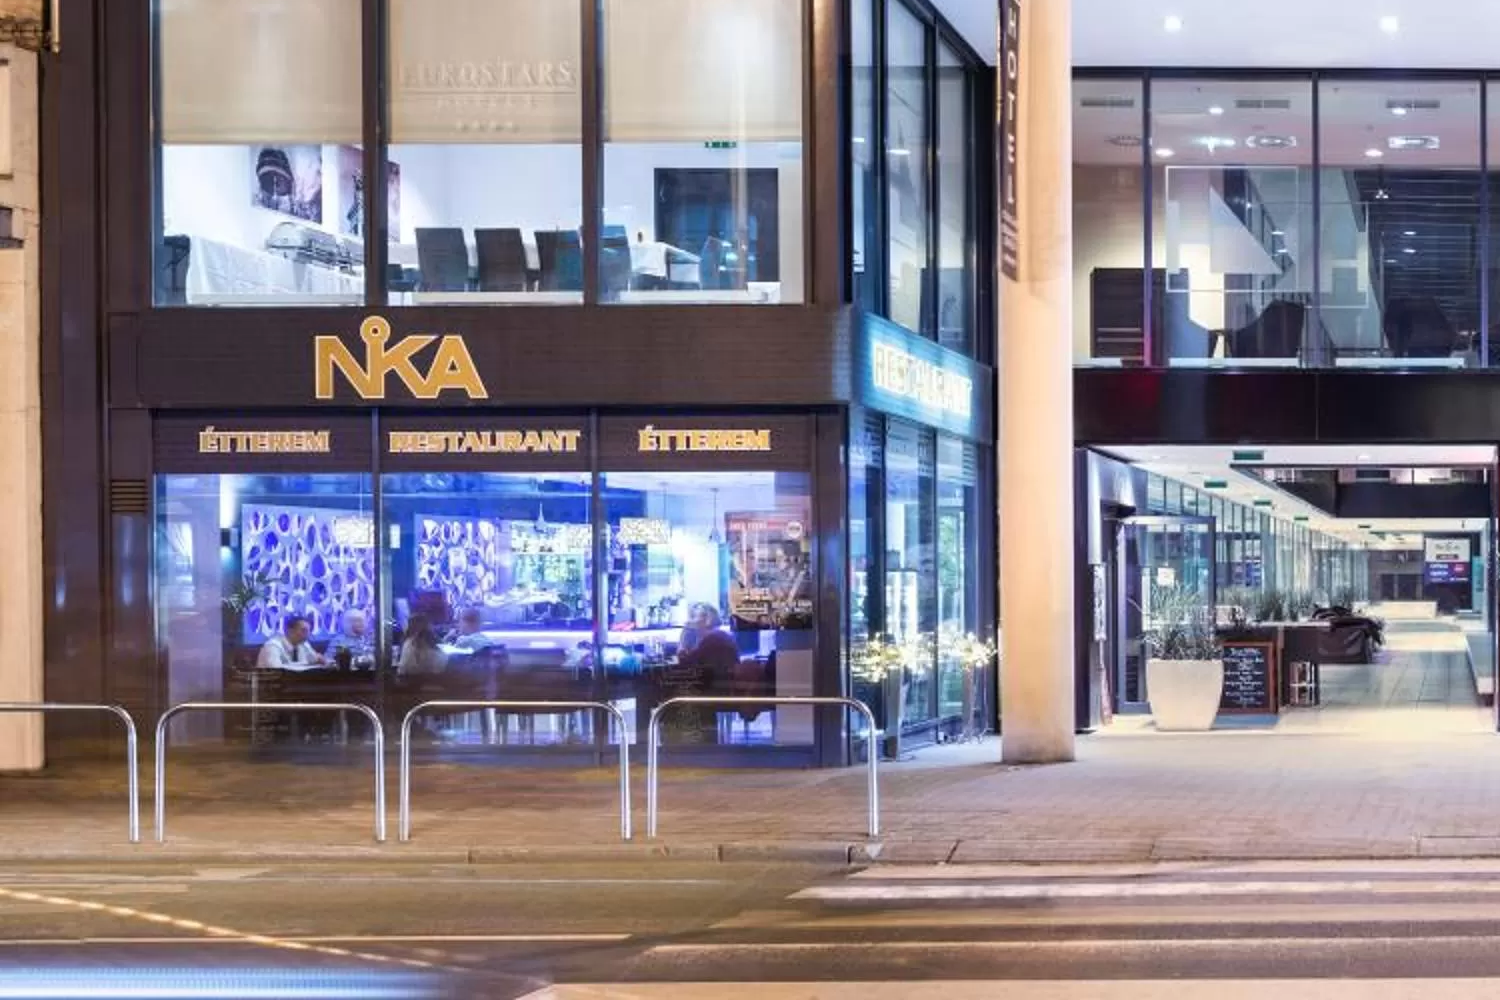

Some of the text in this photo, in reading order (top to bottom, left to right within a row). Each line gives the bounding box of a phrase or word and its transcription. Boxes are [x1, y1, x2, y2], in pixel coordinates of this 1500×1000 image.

[199, 427, 329, 453] ÉTTEREM
[389, 429, 581, 453] RESTAURANT
[638, 425, 771, 451] ÉTTEREM
